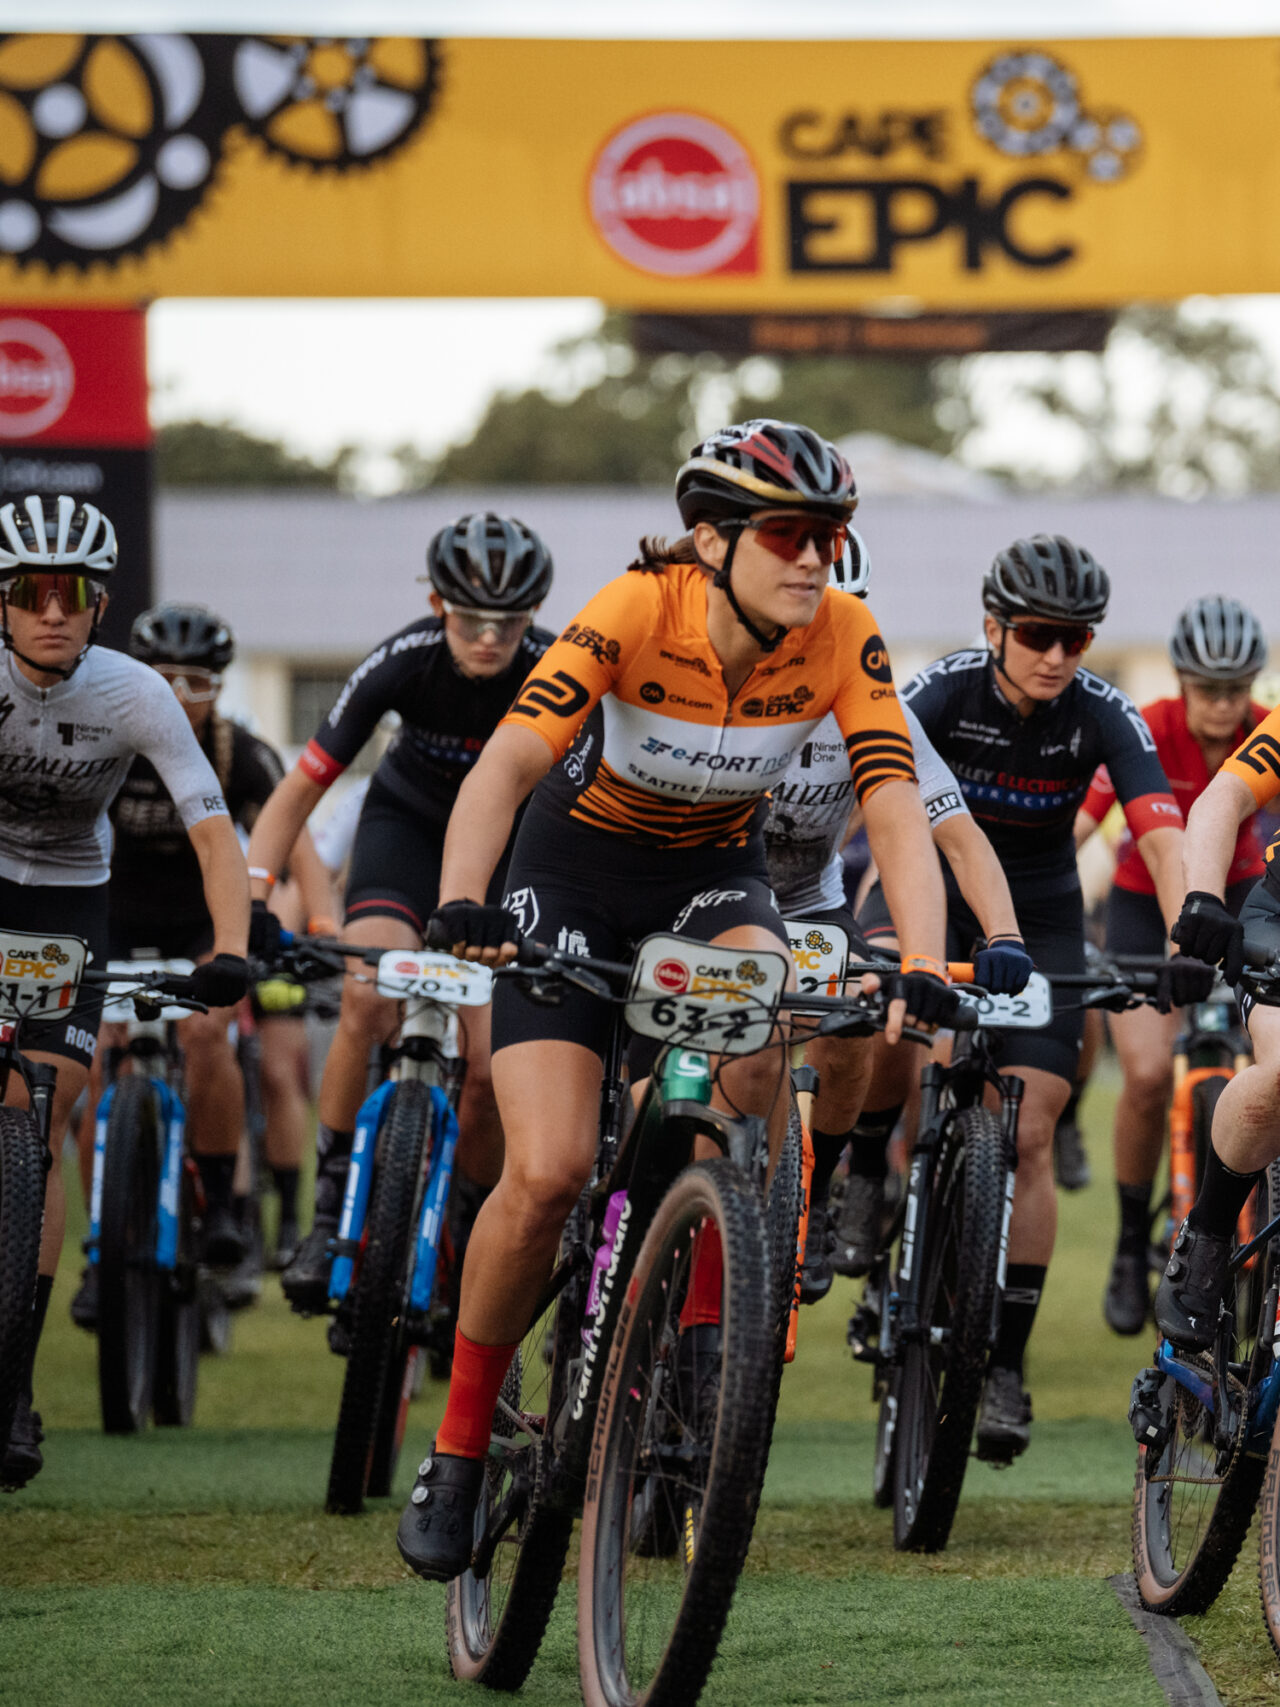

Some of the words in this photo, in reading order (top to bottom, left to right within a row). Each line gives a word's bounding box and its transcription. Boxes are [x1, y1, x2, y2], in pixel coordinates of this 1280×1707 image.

[788, 176, 1074, 274] EPIC
[572, 632, 609, 665] EPIC
[668, 694, 713, 710] CM.com
[765, 701, 804, 717] EPIC
[75, 723, 113, 736] Ninety
[75, 733, 99, 742] One
[812, 753, 836, 763] One
[813, 742, 848, 753] Ninety
[0, 754, 120, 779] CIALIZED
[949, 760, 995, 781] ALLEY
[628, 763, 702, 794] SEATTLE
[772, 780, 852, 806] ALIZED
[926, 793, 959, 818] CLIF
[789, 938, 803, 949] PE
[8, 949, 39, 961] CAPE
[791, 951, 821, 970] PIC
[4, 959, 57, 979] EPIC
[696, 965, 733, 980] CAPE
[0, 982, 50, 1008] 1-1
[402, 979, 469, 996] 70-1
[691, 976, 752, 1003] EPIC
[651, 1000, 750, 1039] 63-2
[587, 1306, 633, 1503] SCHWALBE
[1262, 1450, 1280, 1556] RACING
[1264, 1564, 1279, 1607] RAY
